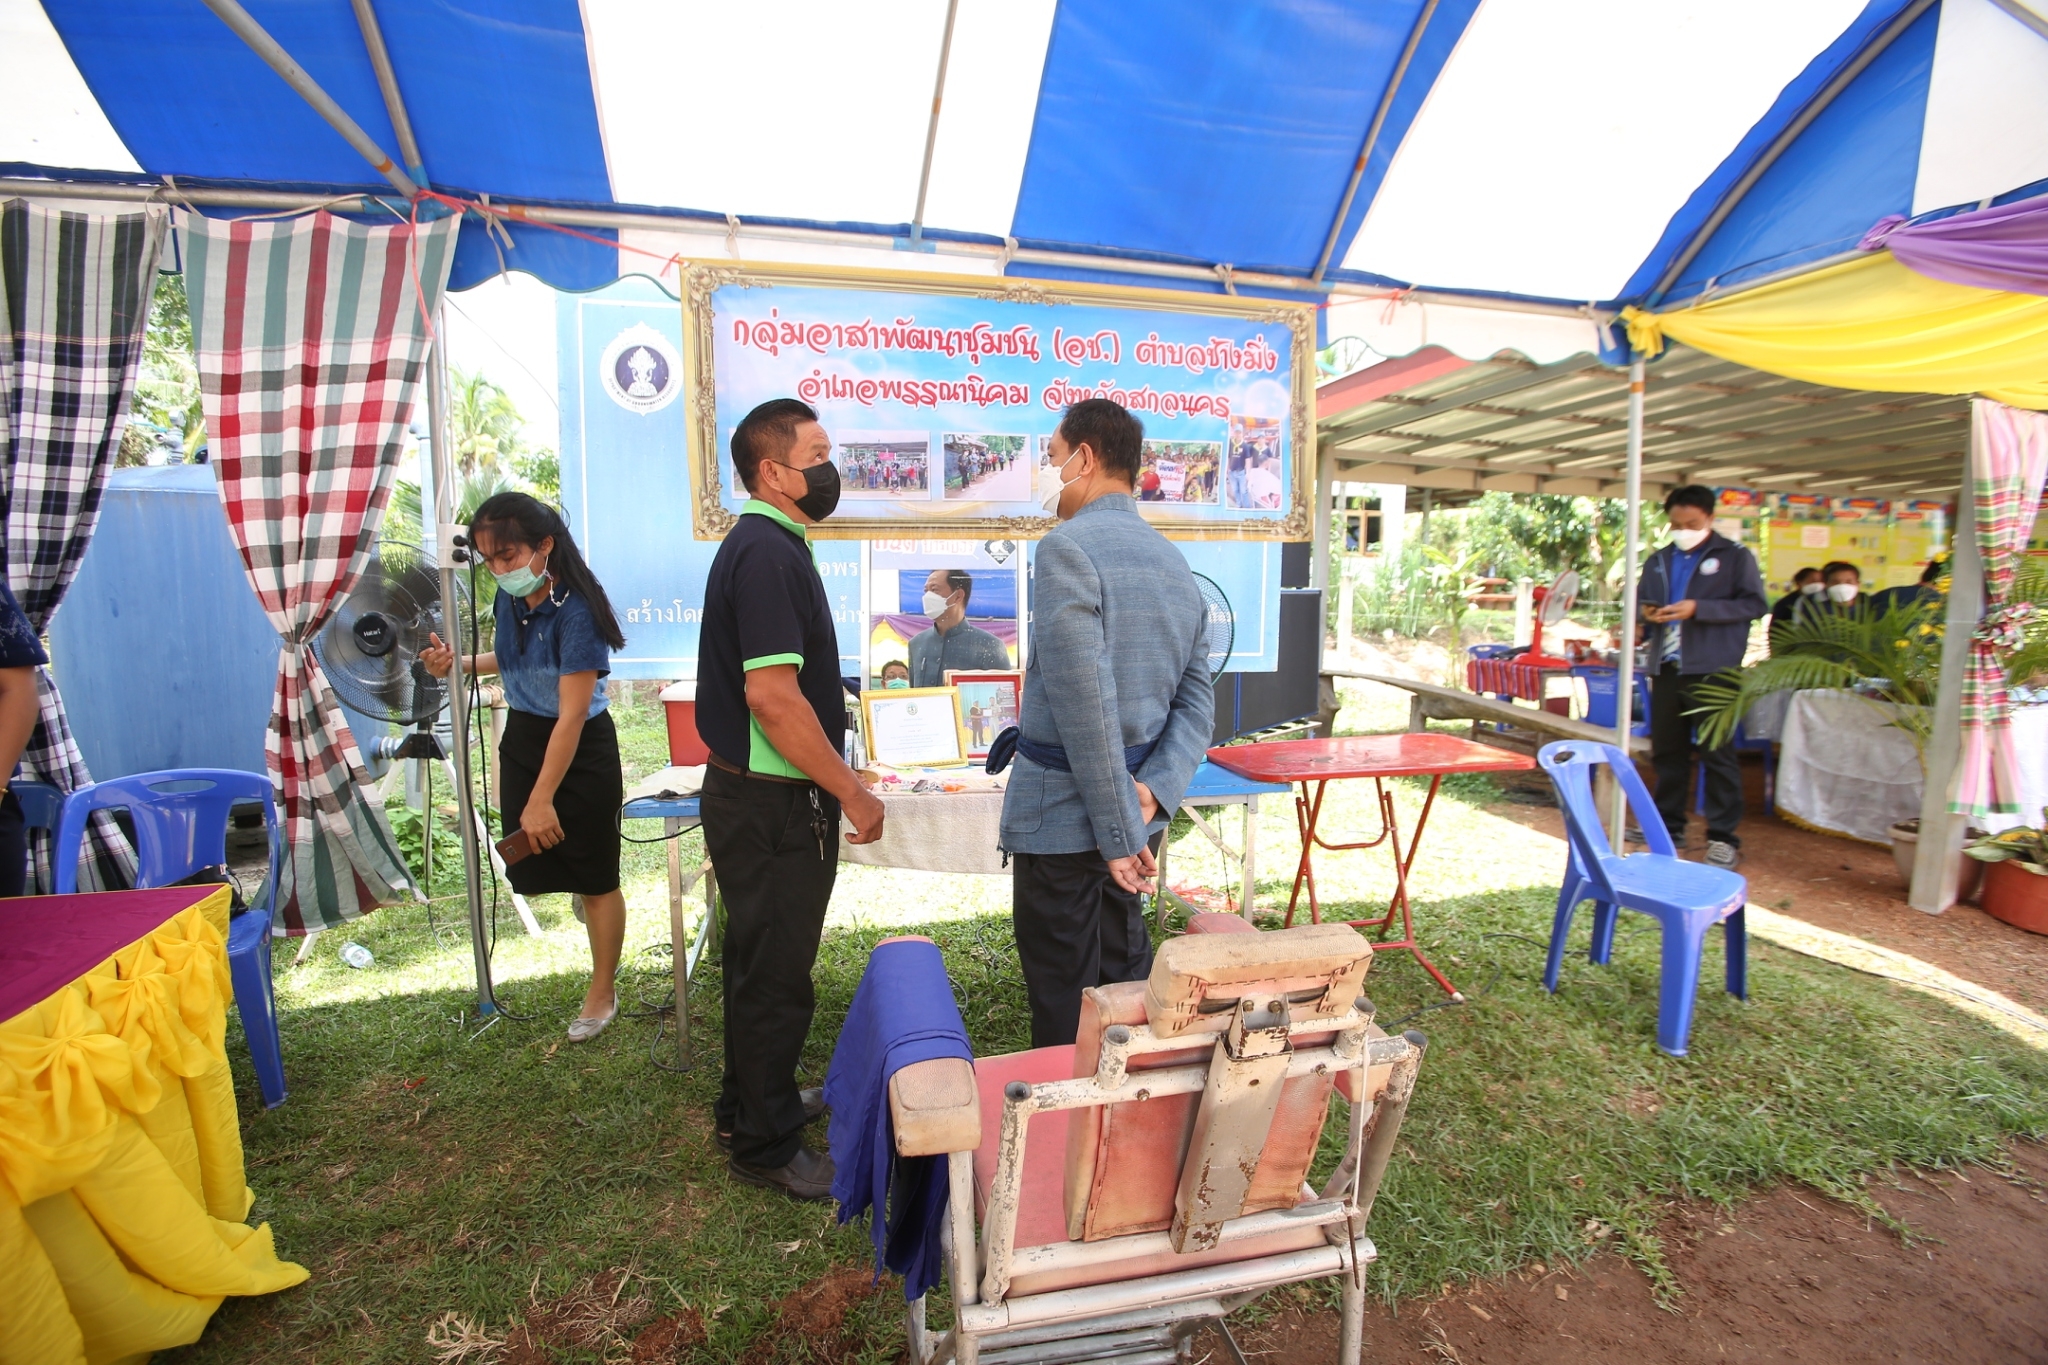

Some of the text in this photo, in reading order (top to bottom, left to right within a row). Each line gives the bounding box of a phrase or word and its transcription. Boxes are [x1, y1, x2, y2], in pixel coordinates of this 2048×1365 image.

[734, 308, 1277, 373] กลุ่มอาสาพัฒนาชุมชน (อช.) ตำบลช้างมิ่ง
[798, 369, 1029, 408] อำเภอพรรณานิคม
[819, 562, 861, 577] อพร
